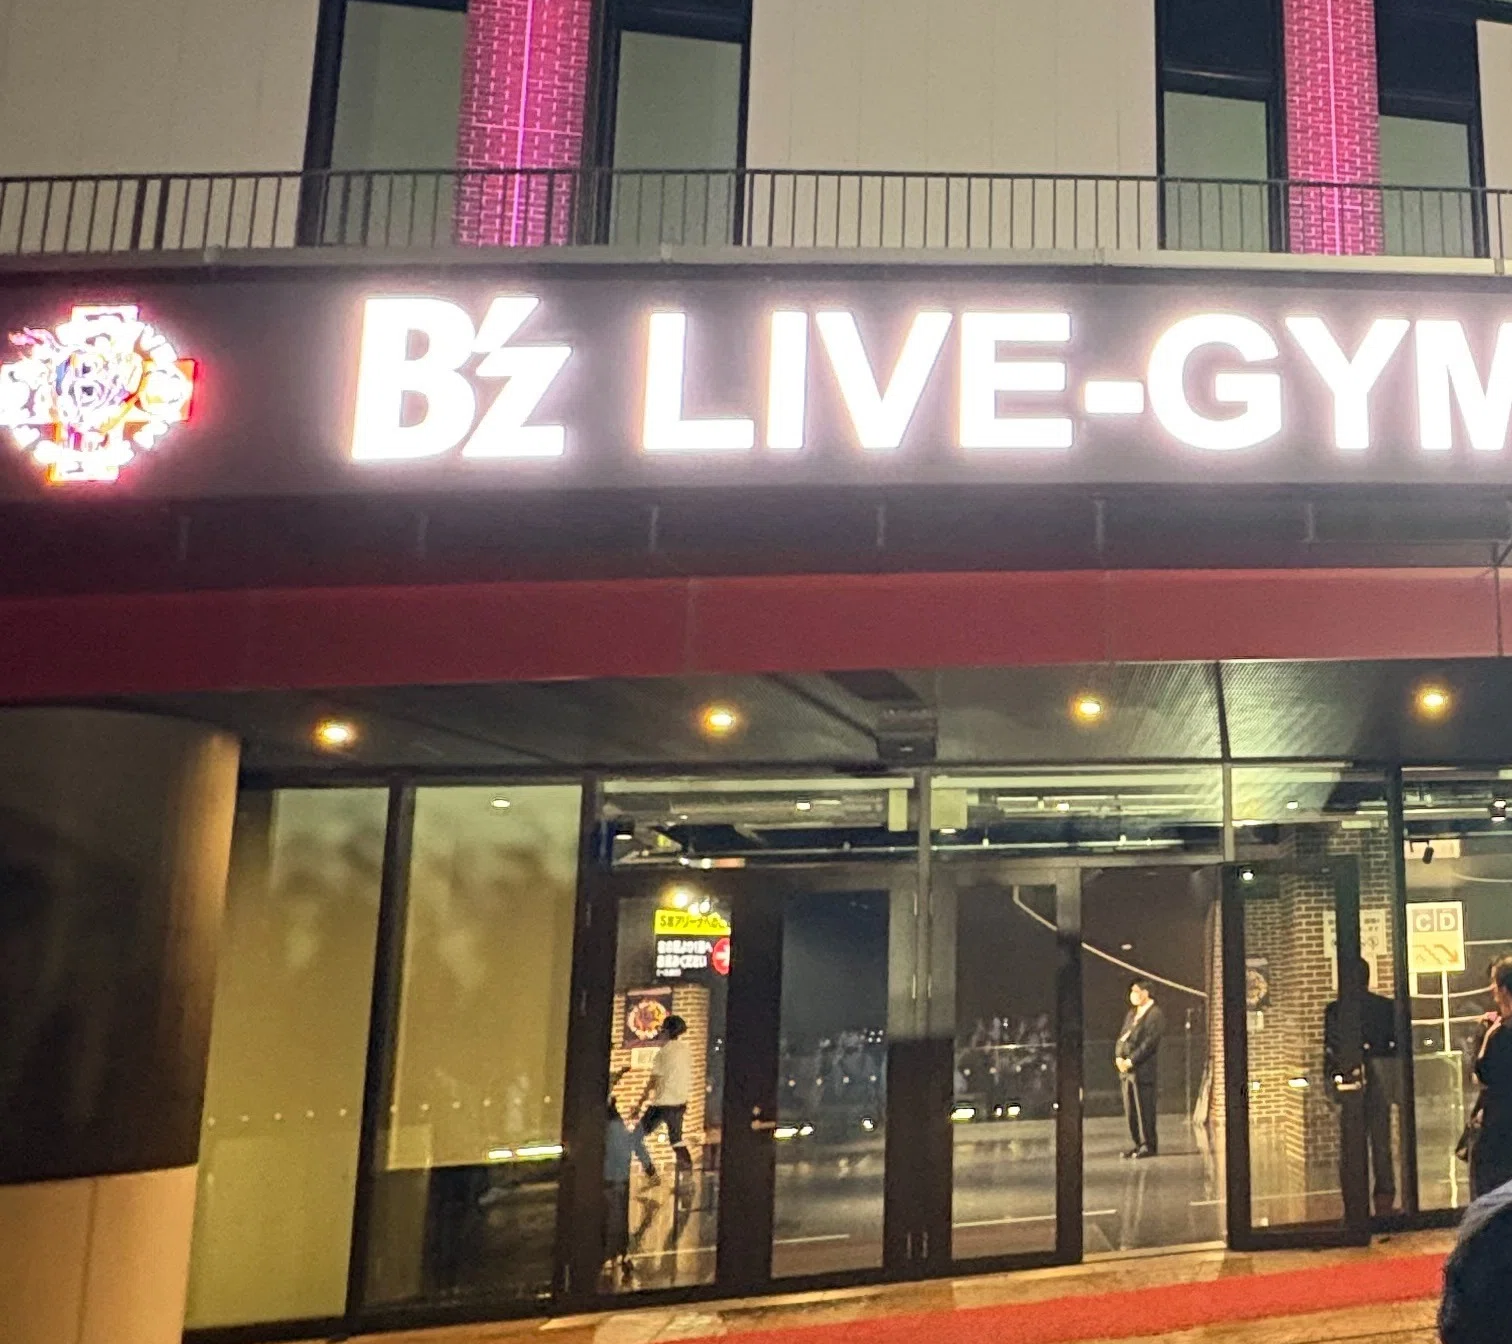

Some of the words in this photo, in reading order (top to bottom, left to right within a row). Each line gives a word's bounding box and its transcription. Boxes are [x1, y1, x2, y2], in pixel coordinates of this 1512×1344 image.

[354, 297, 572, 460] B'z
[1415, 913, 1432, 932] C
[1439, 912, 1456, 931] D
